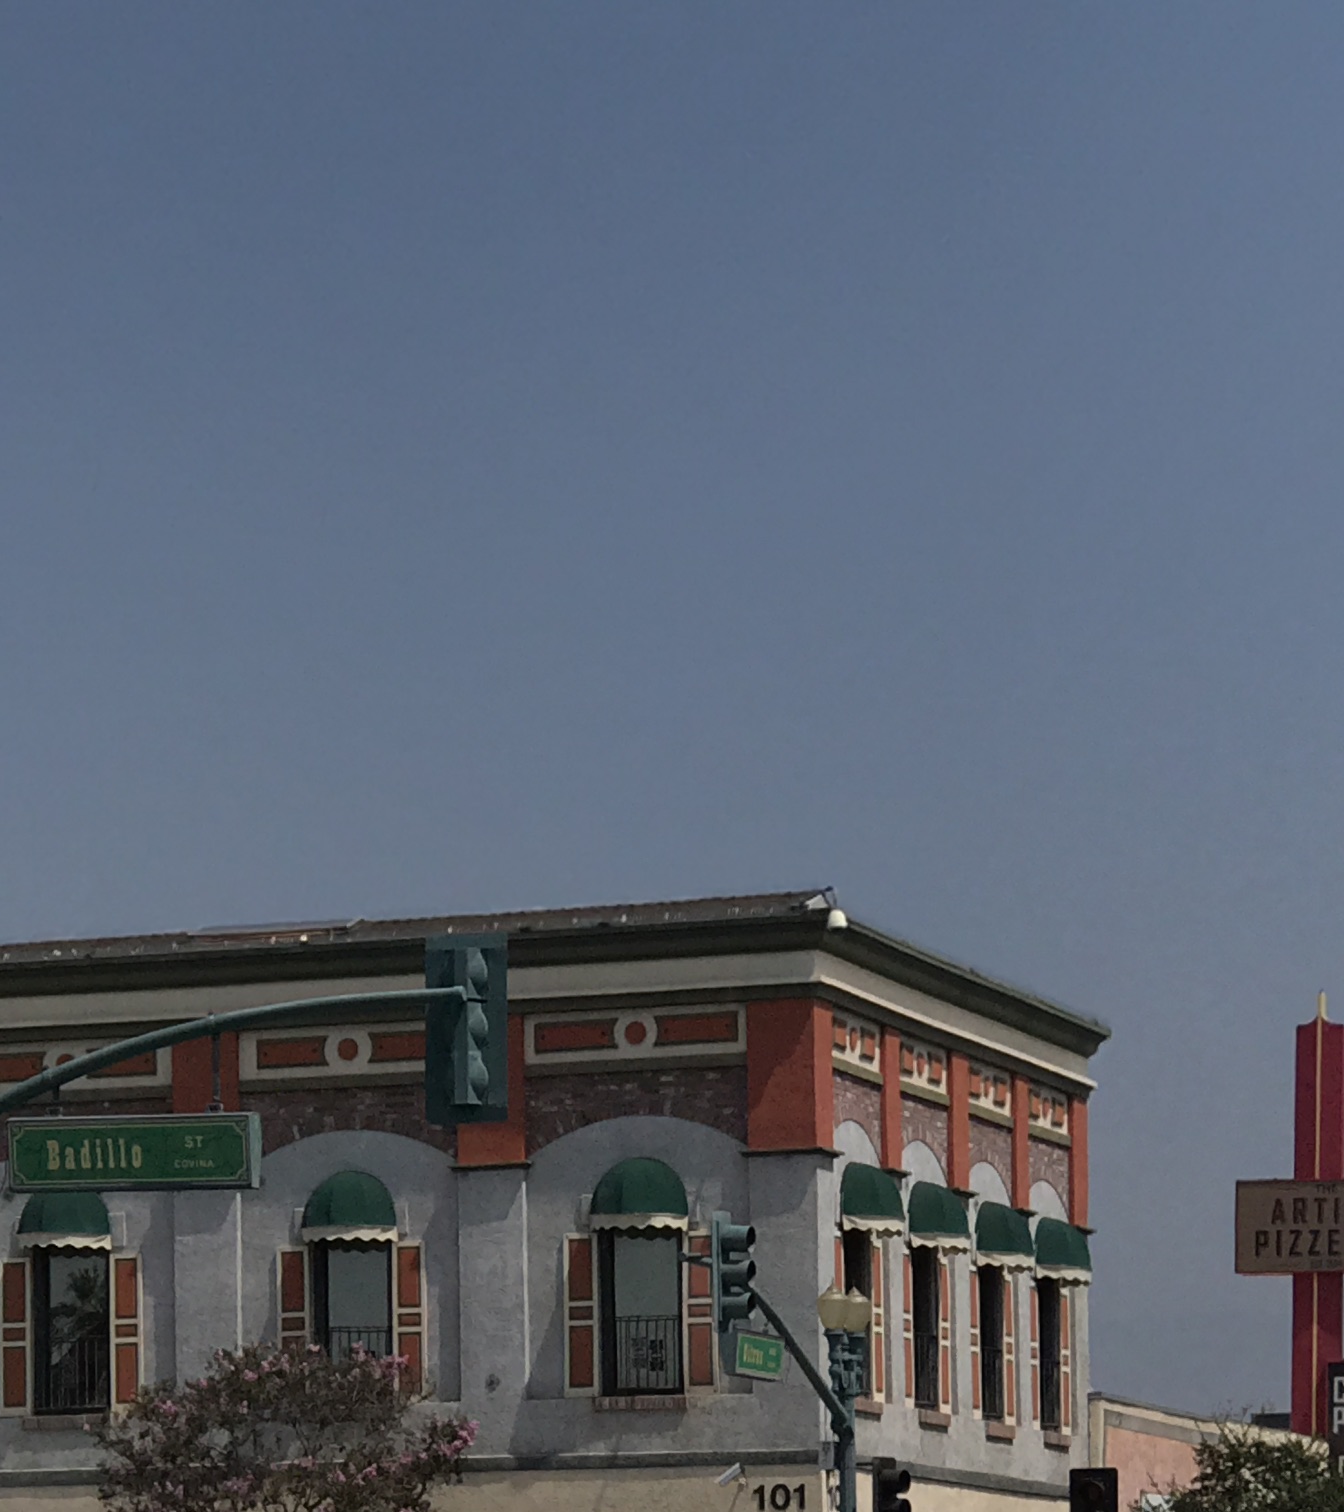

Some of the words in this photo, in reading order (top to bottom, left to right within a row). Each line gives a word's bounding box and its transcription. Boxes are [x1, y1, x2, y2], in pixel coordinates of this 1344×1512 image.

[46, 1138, 143, 1171] Badillo
[184, 1135, 204, 1149] ST
[753, 1483, 805, 1512] 101
